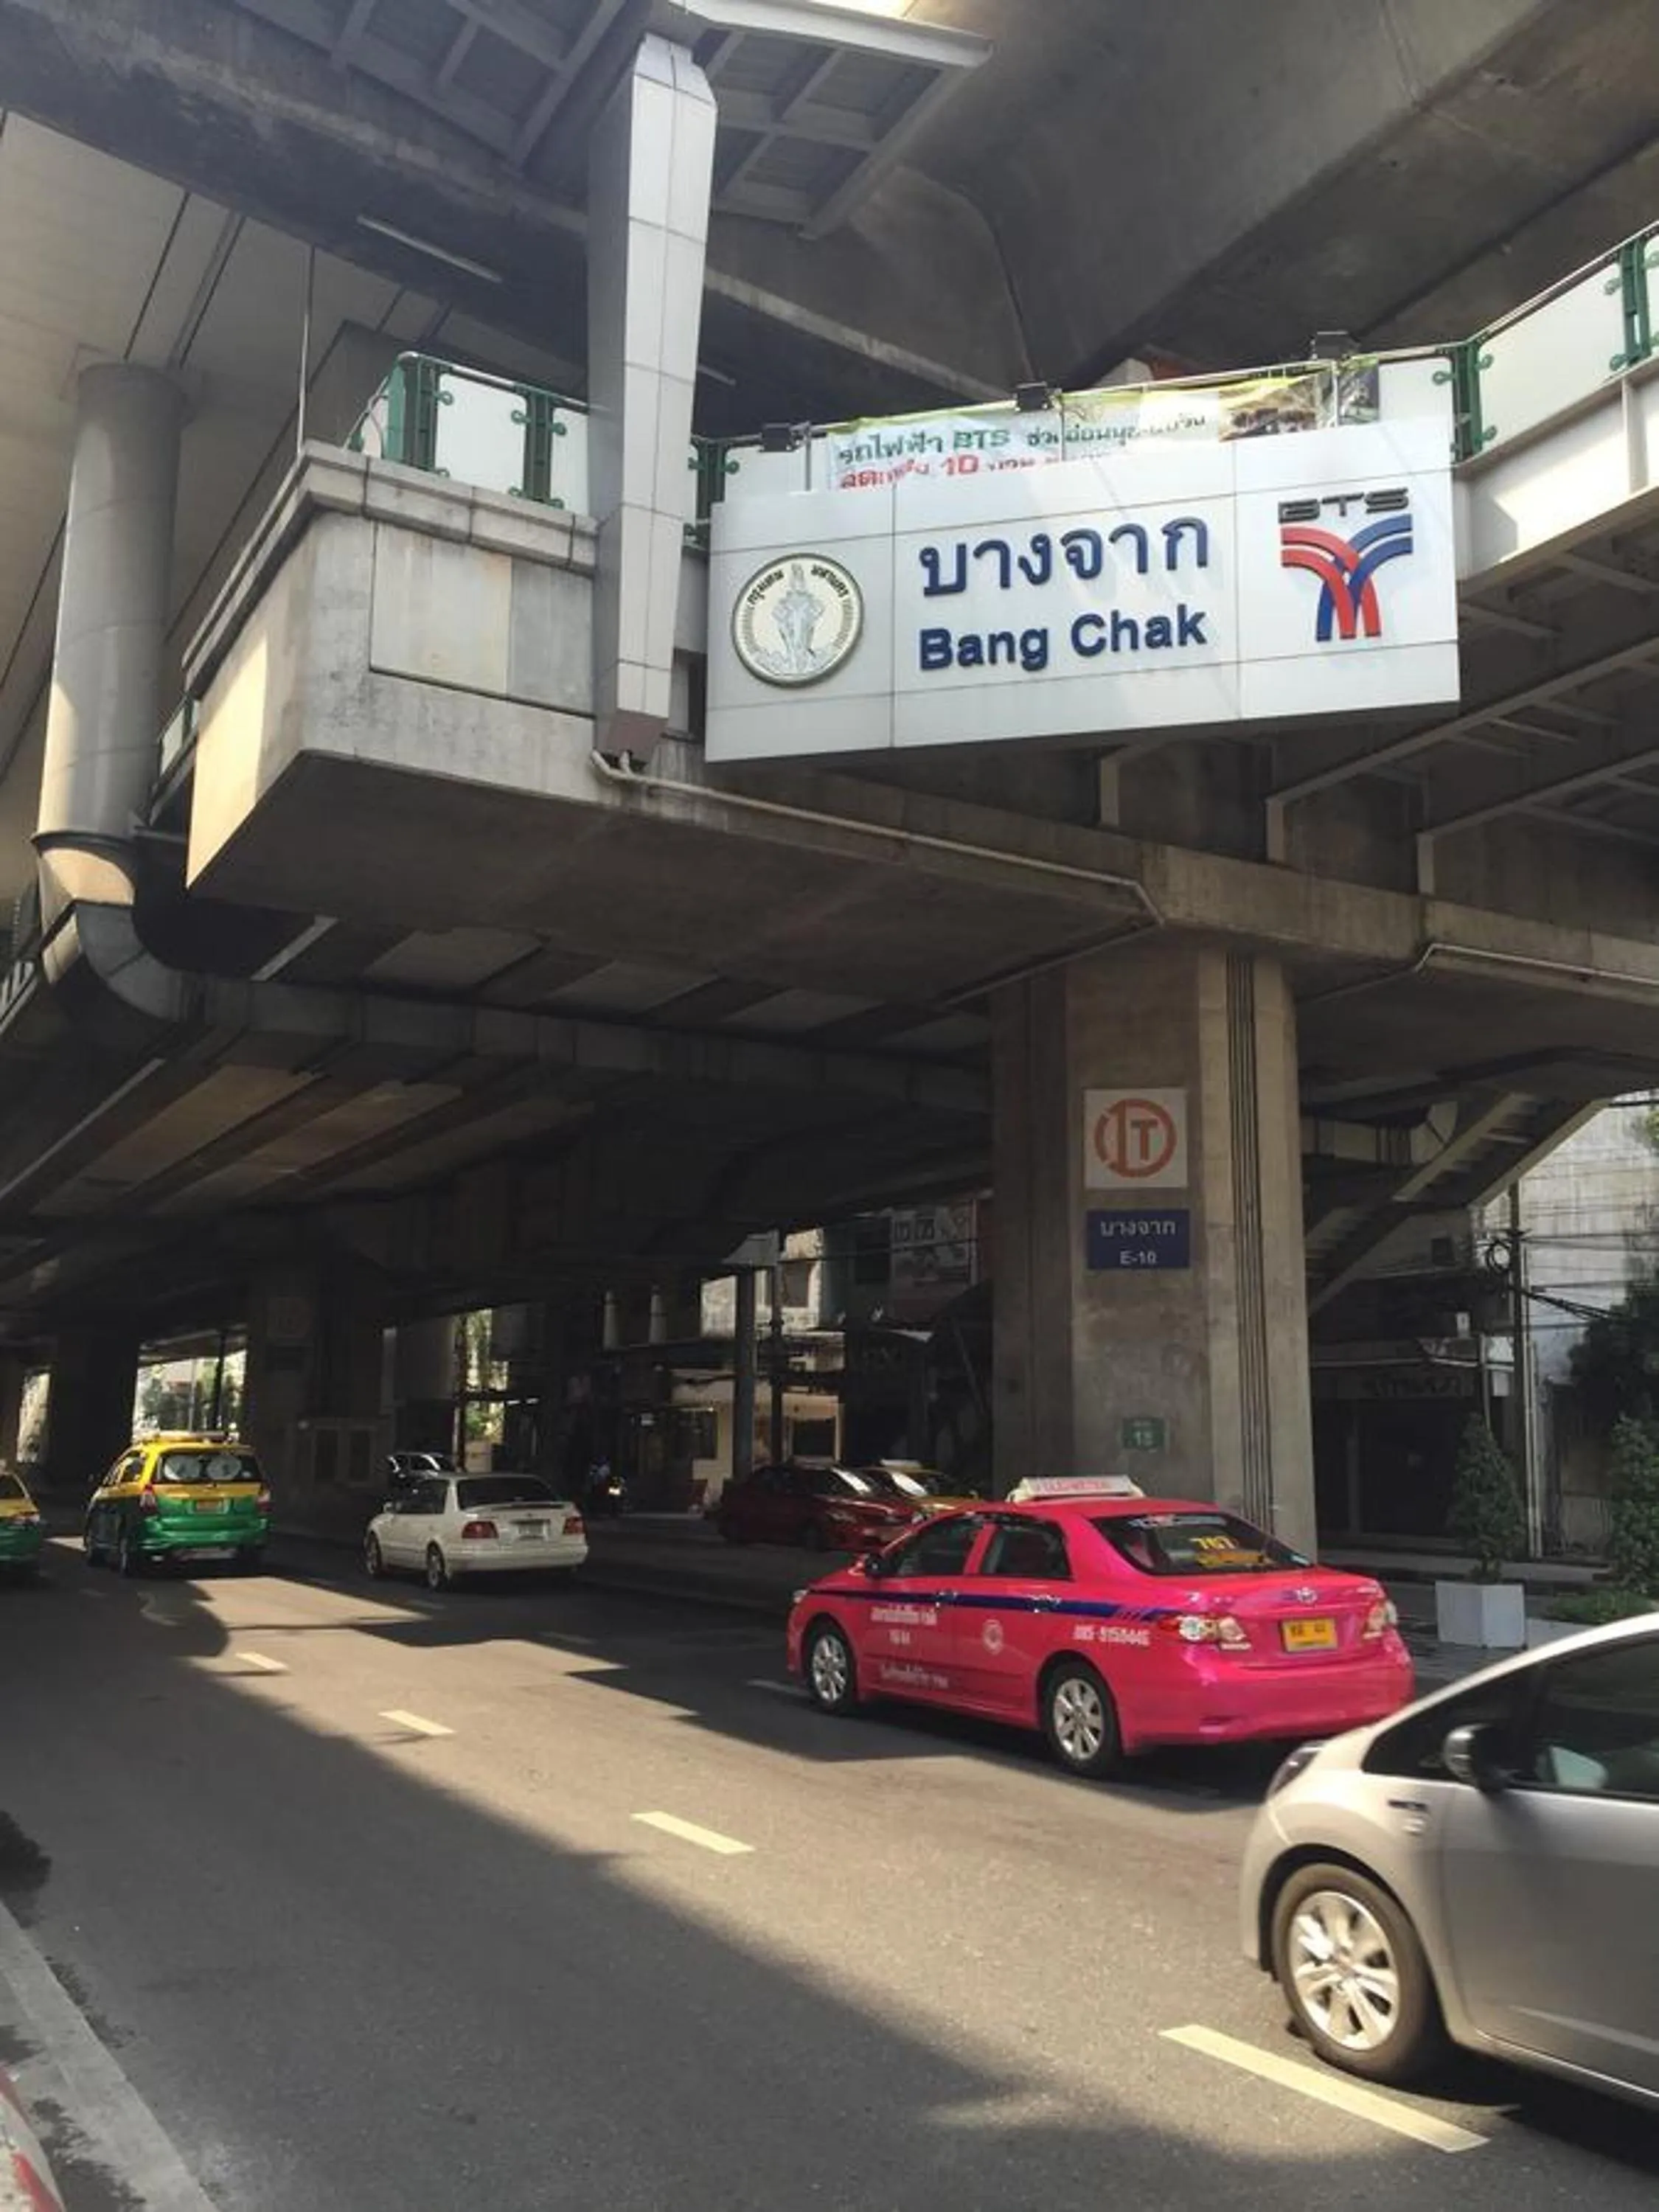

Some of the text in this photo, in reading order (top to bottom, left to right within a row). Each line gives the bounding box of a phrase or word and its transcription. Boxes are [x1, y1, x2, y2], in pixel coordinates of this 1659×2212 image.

[952, 428, 1011, 451] BTS
[1279, 487, 1409, 524] BTS
[919, 515, 1209, 597] บางจาก
[919, 603, 1208, 672] Bang Chak
[1099, 1220, 1177, 1238] บางจาก
